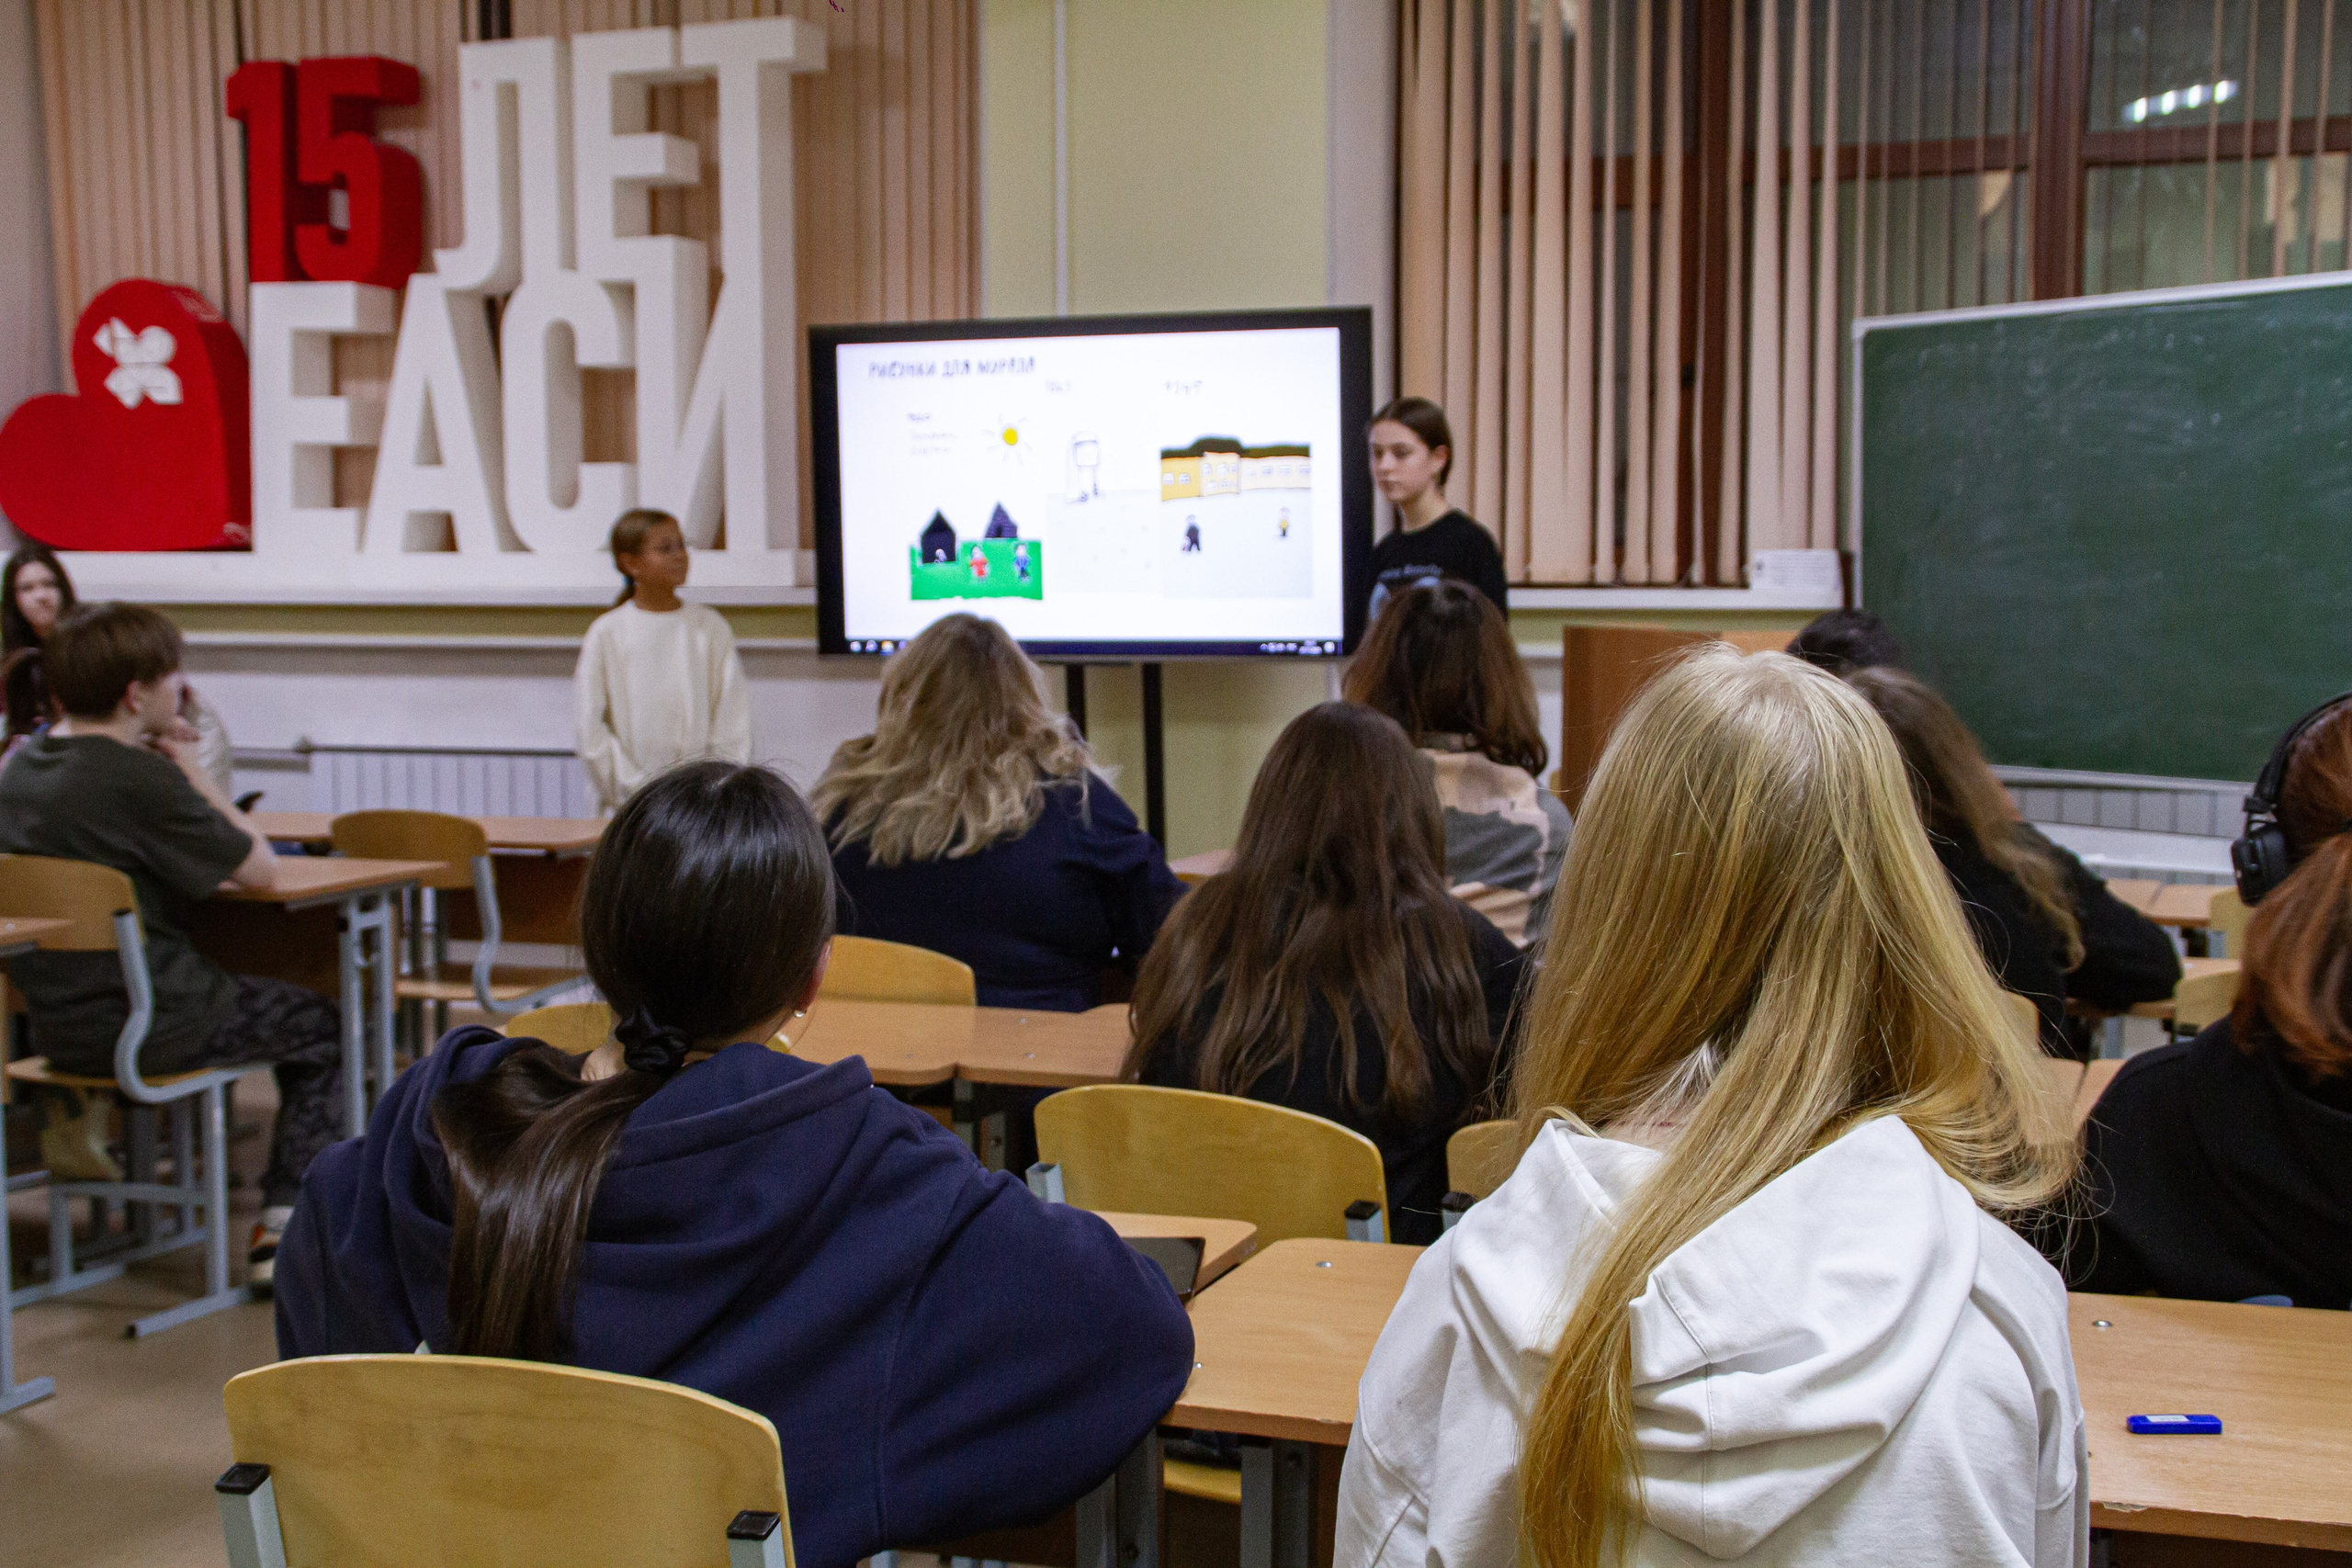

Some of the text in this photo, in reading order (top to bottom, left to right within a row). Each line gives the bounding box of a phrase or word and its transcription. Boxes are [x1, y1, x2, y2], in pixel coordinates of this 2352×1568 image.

[227, 17, 827, 294] 15 ЛЕТ
[251, 237, 796, 553] ЕАСИ
[942, 358, 971, 378] ДЛЯ
